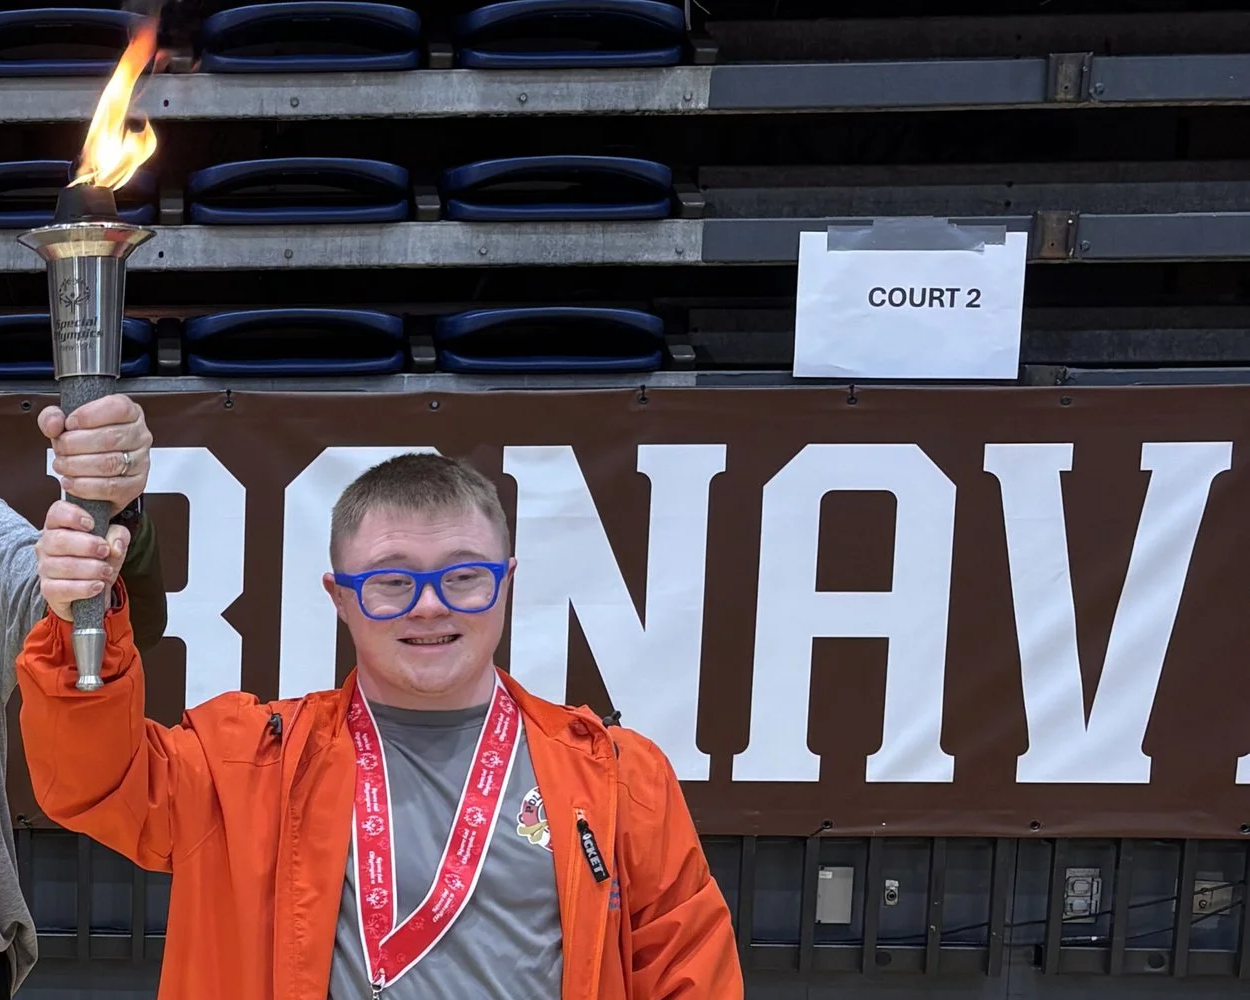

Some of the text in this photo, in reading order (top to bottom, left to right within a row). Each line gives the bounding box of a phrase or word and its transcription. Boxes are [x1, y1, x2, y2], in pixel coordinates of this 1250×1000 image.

[868, 287, 982, 308] COURT 2
[582, 830, 606, 877] OCKET
